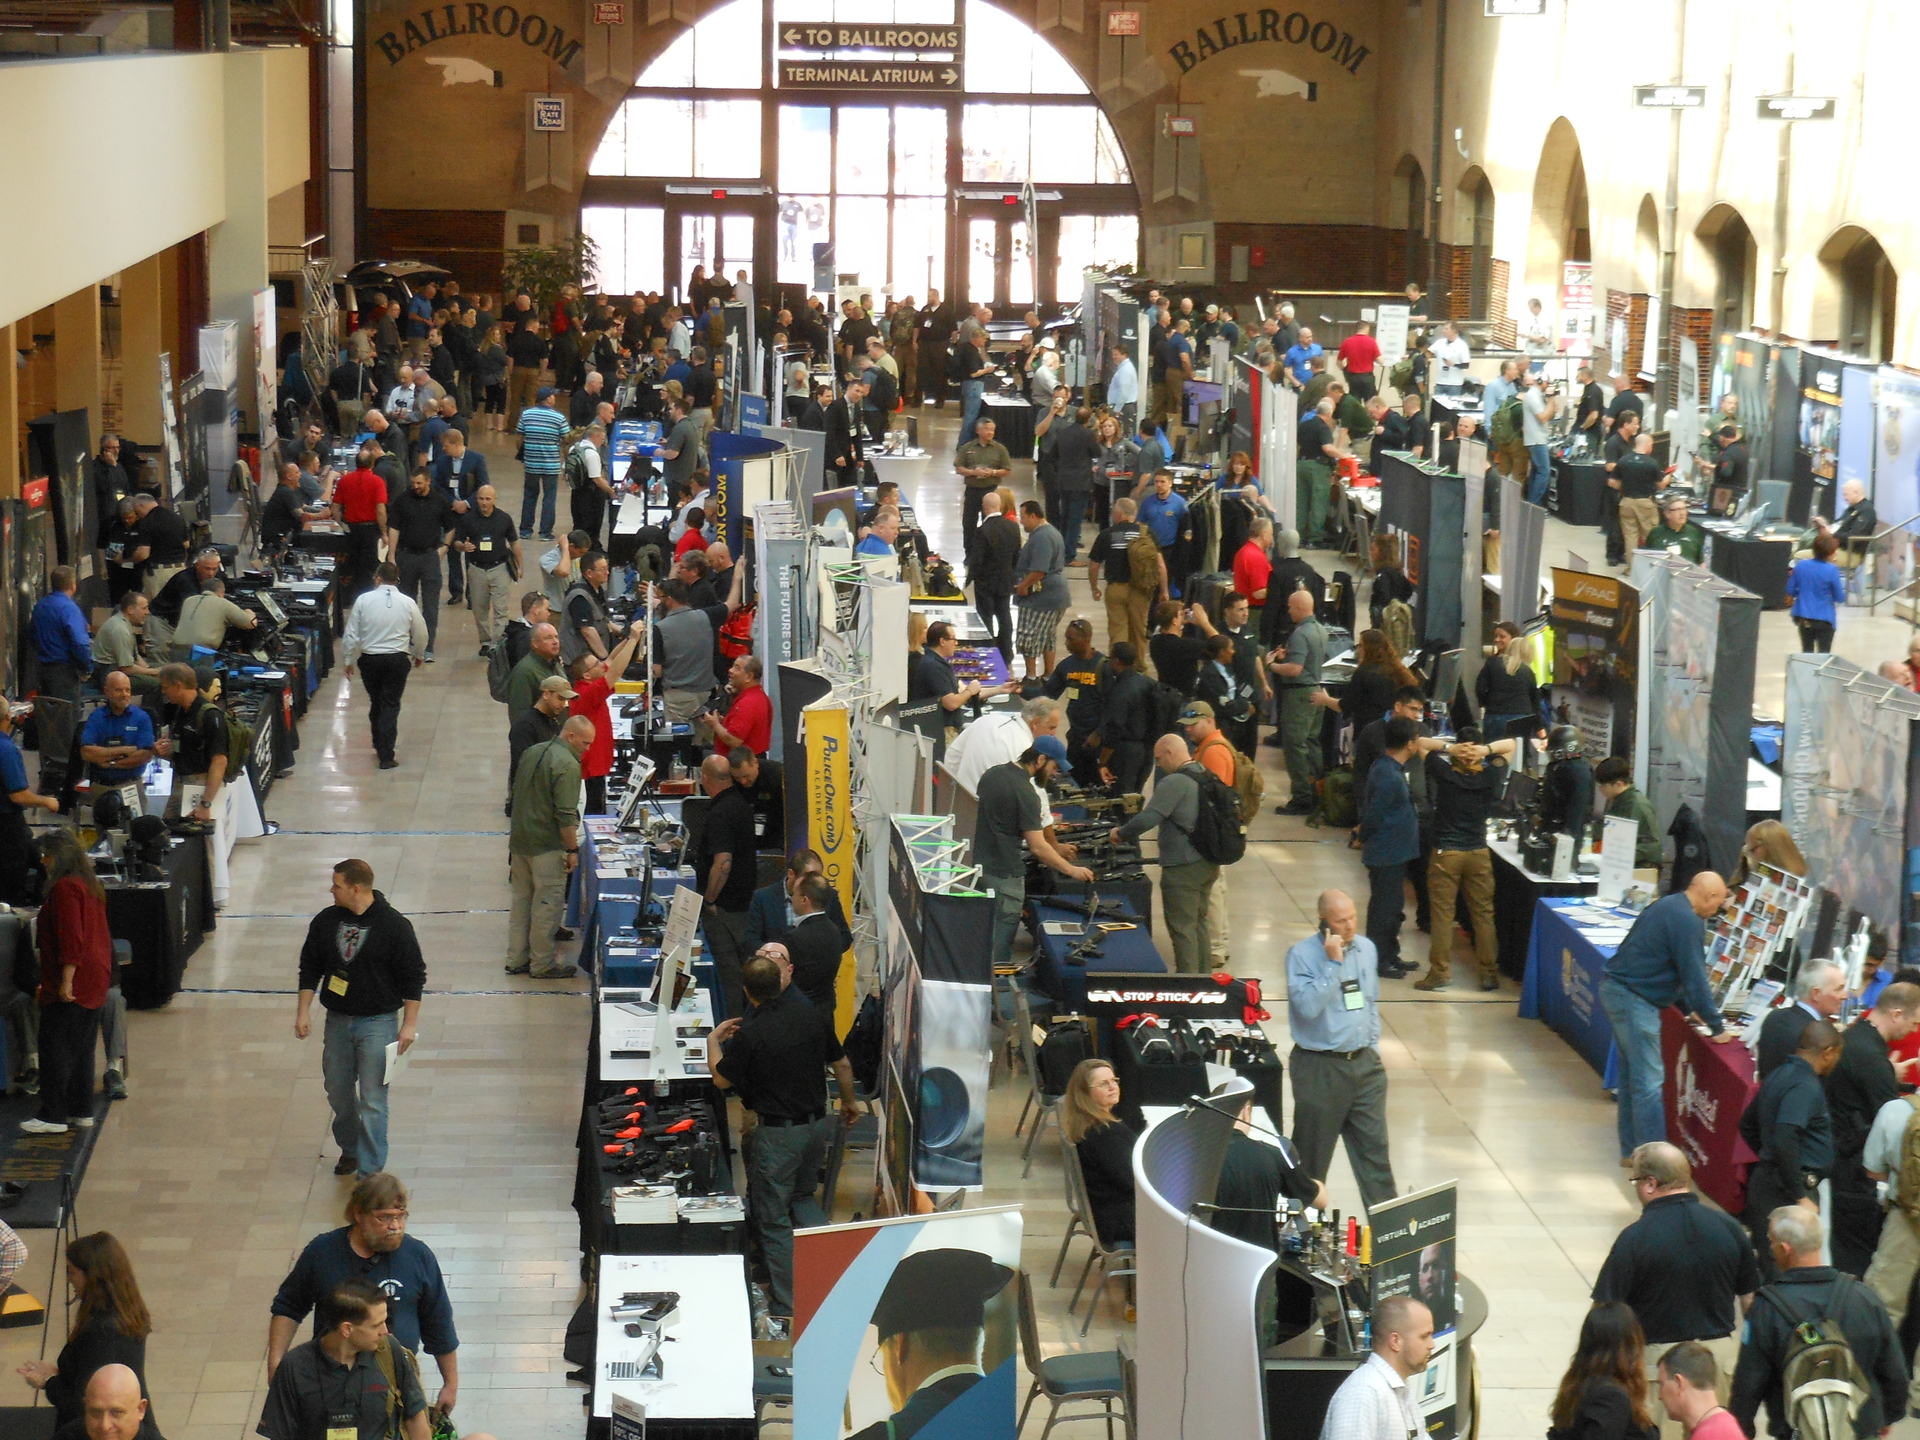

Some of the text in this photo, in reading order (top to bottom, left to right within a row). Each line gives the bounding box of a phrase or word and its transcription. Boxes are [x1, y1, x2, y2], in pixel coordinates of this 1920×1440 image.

[375, 2, 584, 70] BALLROOM
[806, 29, 958, 48] TO BALLROOMS
[1168, 8, 1372, 76] BALLROOM
[787, 68, 934, 83] TERMINAL ATRIUM
[779, 565, 788, 588] THE
[780, 592, 791, 639] FUTURE
[814, 769, 822, 822] ACADEMY
[1123, 991, 1154, 1002] STOP
[1156, 992, 1192, 1002] STICK
[1377, 1212, 1451, 1243] VIRTUAL ACADEMY
